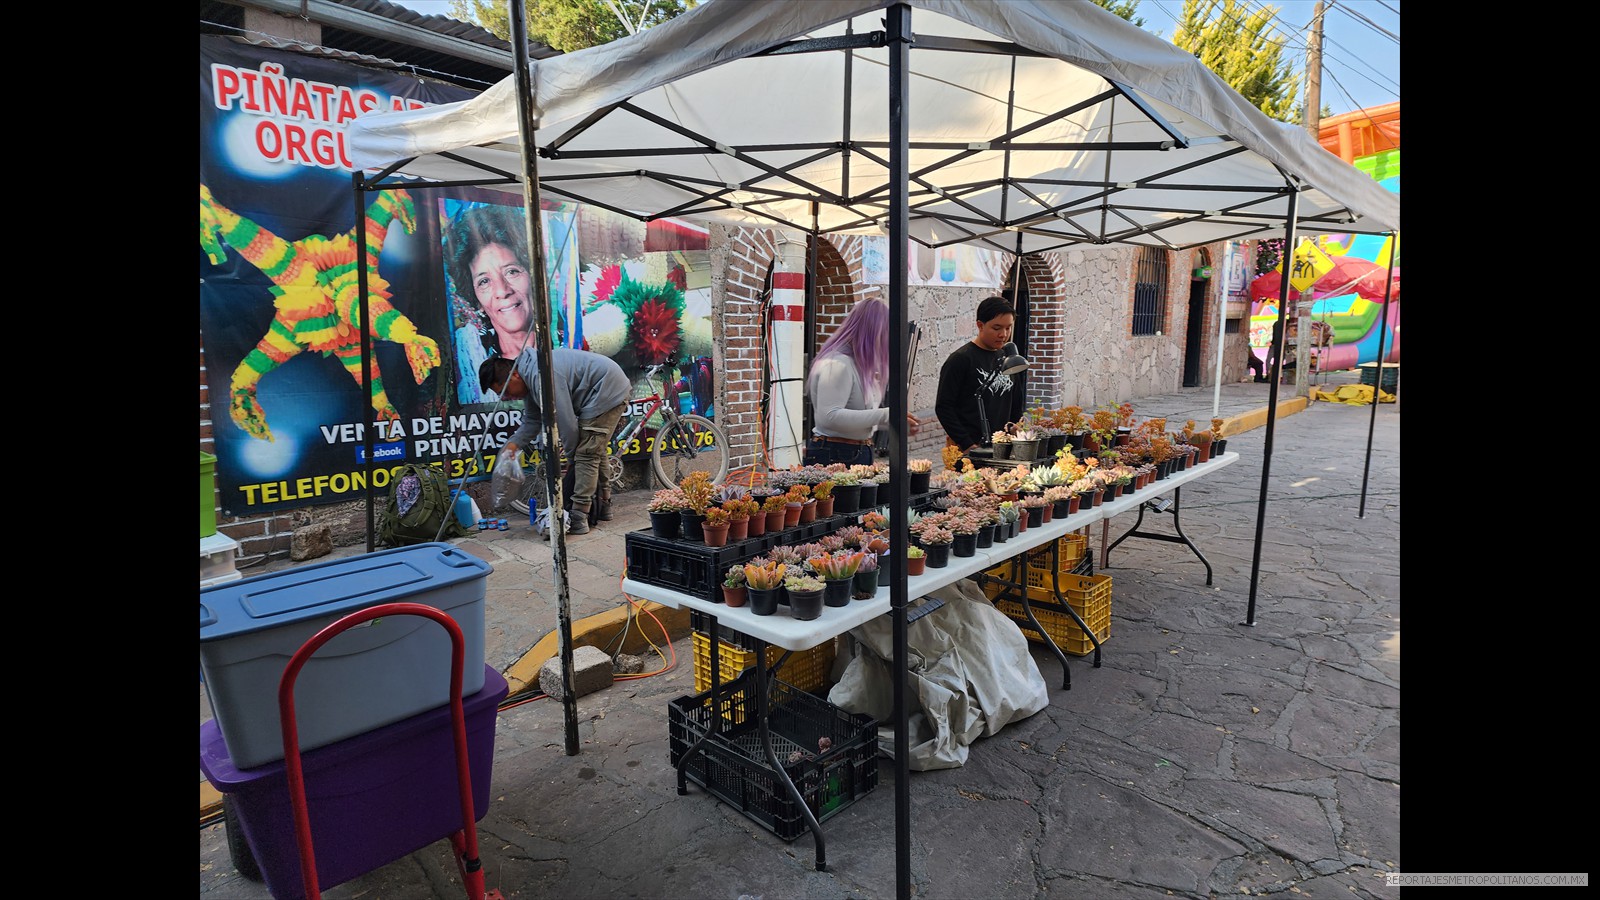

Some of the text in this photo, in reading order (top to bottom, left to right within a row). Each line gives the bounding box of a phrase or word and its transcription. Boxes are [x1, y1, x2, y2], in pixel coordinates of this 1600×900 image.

[255, 120, 353, 168] ORGU
[412, 417, 444, 436] DE
[449, 410, 526, 432] MAYOR
[414, 431, 508, 458] PIÑATAS
[695, 431, 714, 447] 76
